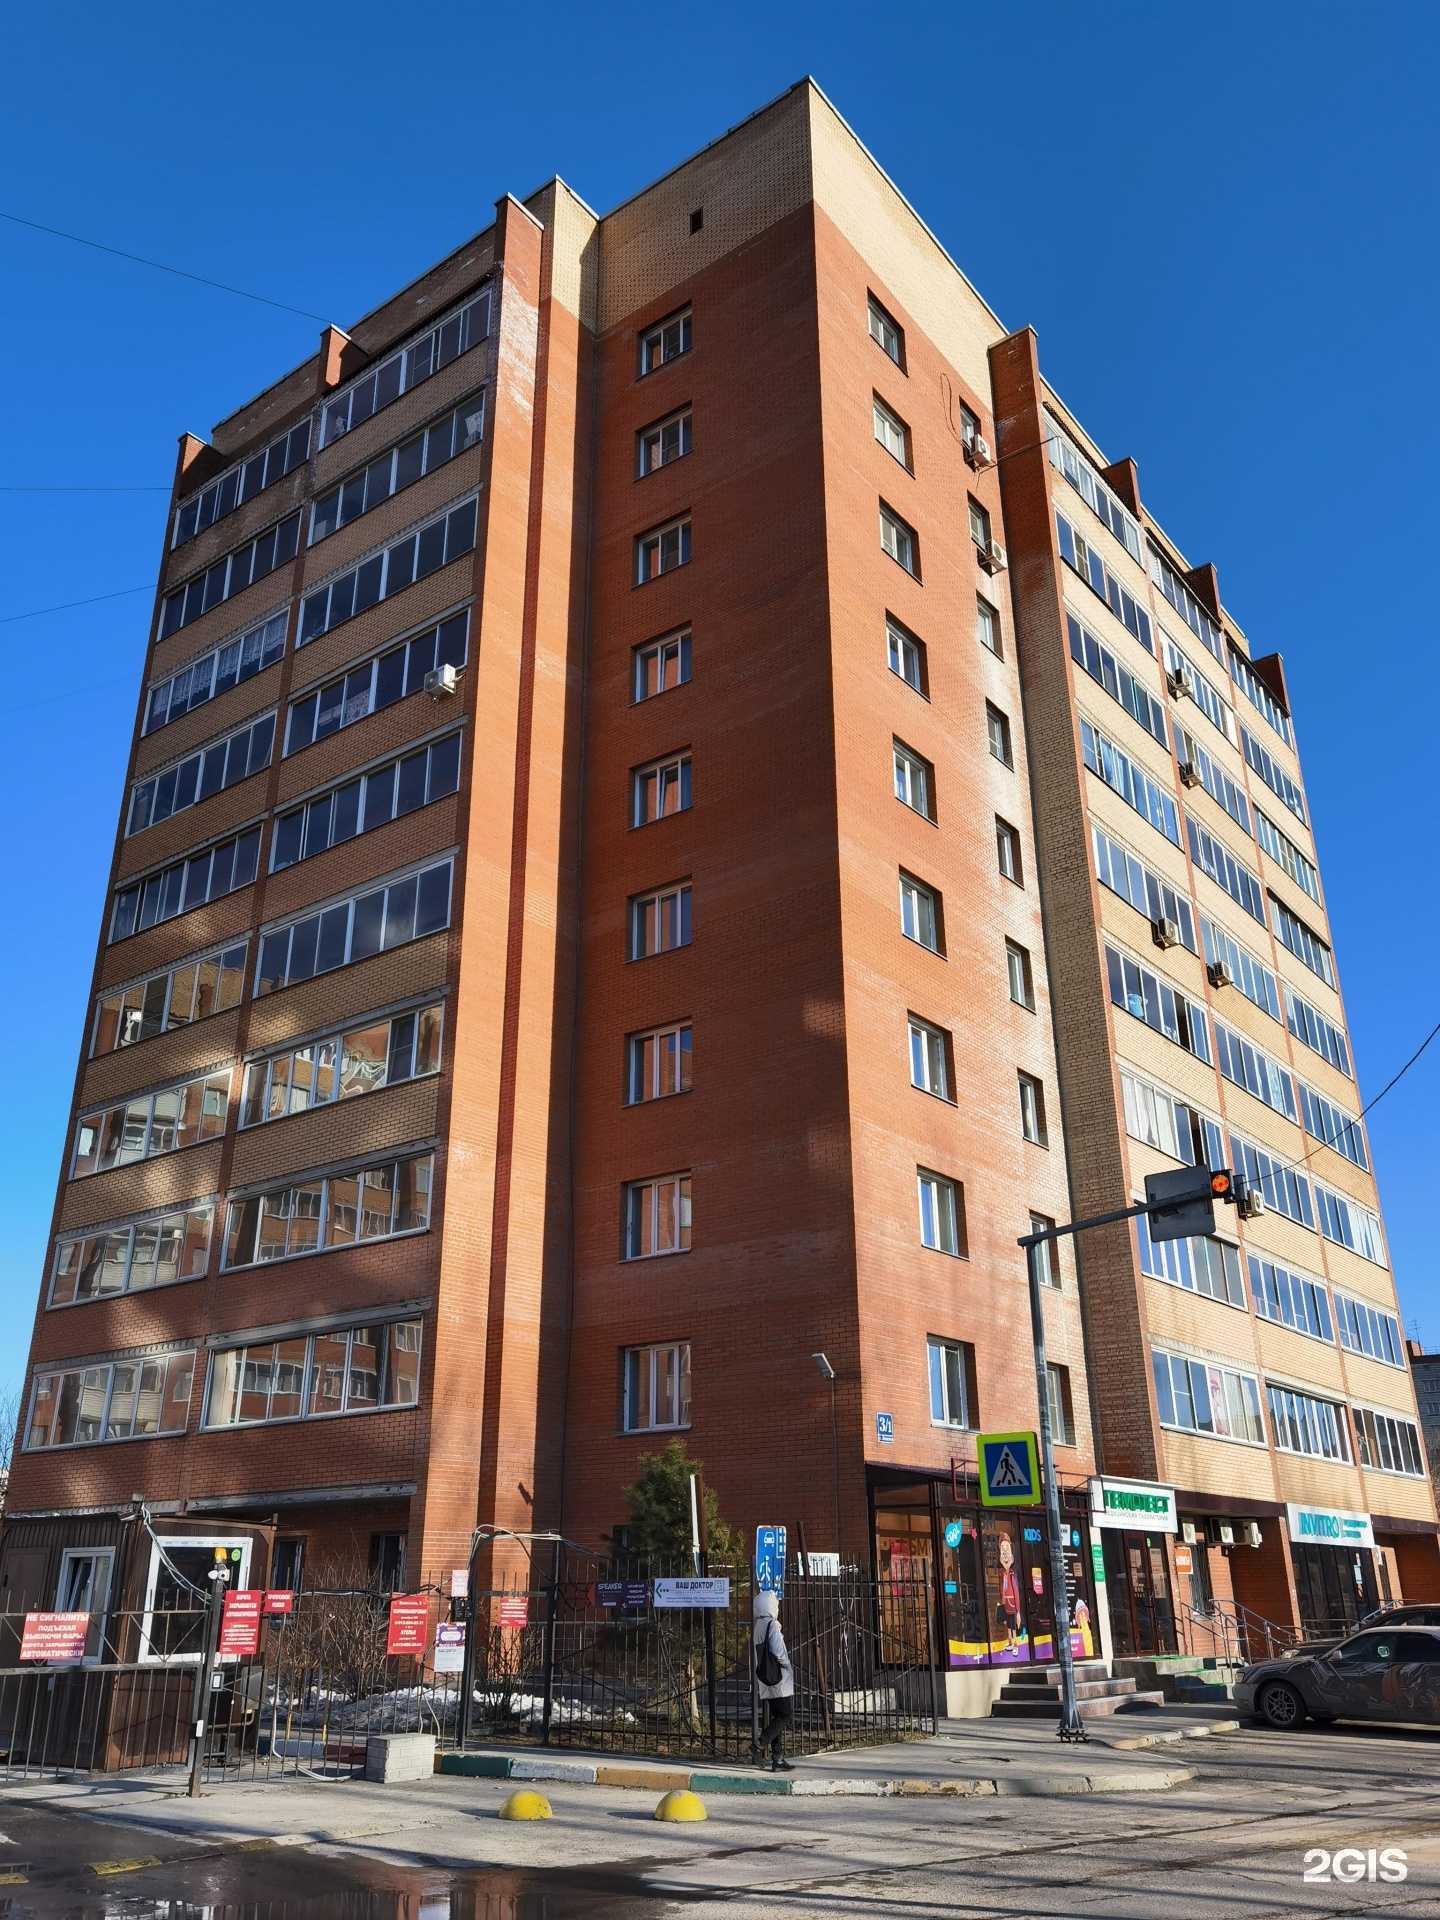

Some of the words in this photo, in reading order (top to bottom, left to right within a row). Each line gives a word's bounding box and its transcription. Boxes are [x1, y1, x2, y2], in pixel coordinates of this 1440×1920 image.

[879, 1416, 892, 1433] 3/1
[1298, 1512, 1340, 1538] INVITRO
[1023, 1527, 1042, 1542] KIDS
[675, 1581, 689, 1589] ВАШ
[690, 1582, 713, 1590] ДОКТОР
[27, 1613, 40, 1621] НЕ
